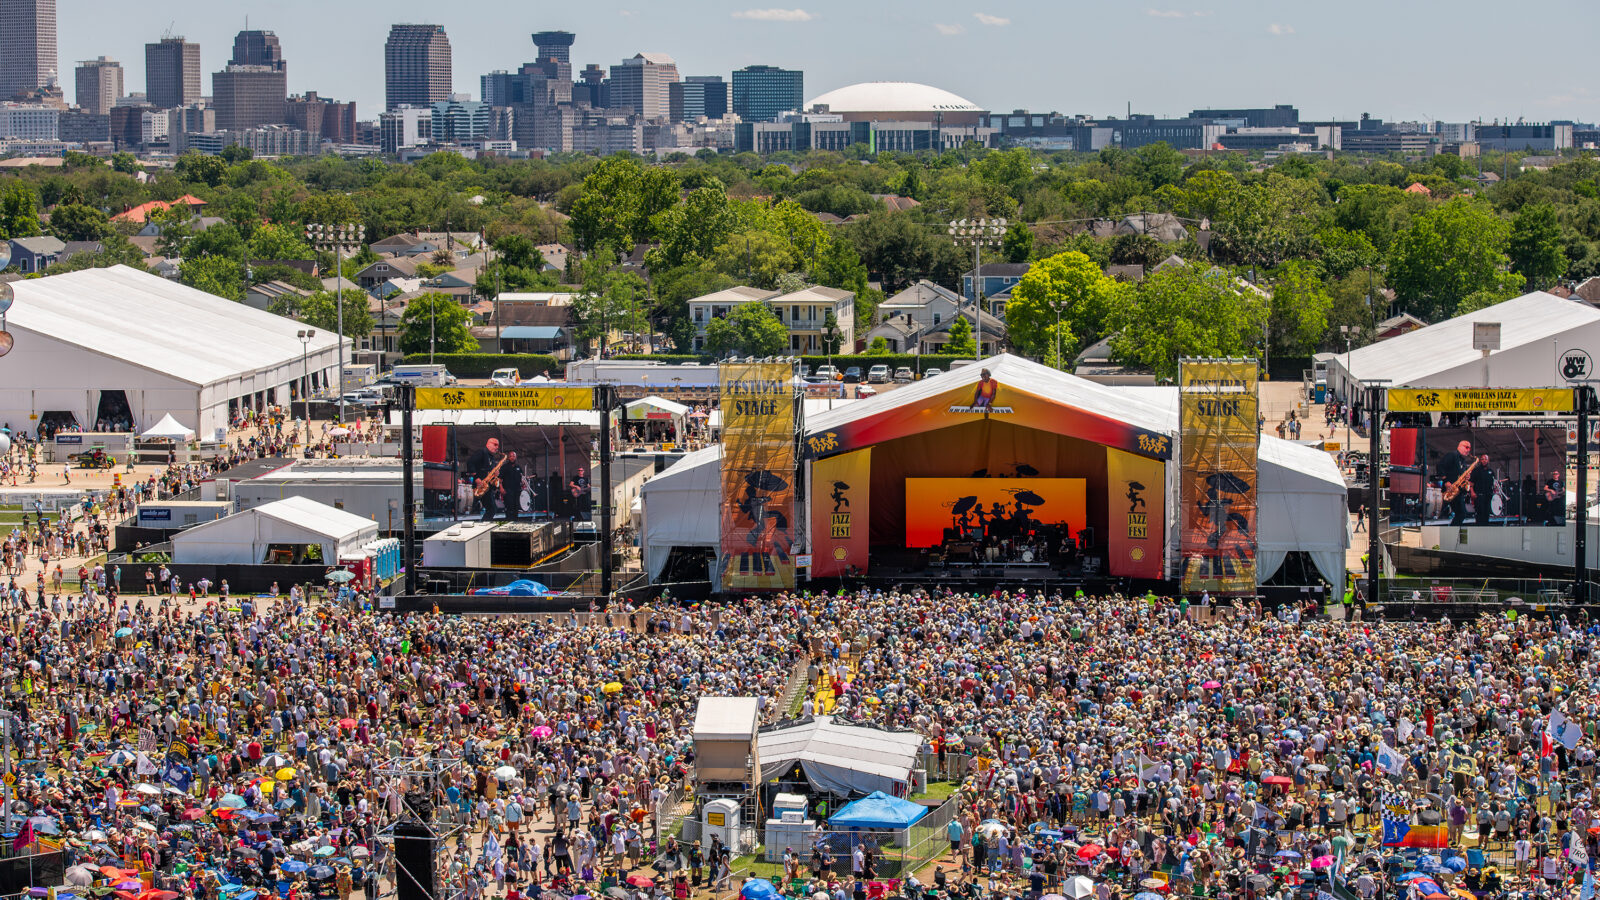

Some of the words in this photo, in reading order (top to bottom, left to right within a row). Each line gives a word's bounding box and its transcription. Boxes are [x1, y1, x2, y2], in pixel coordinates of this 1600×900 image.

[727, 379, 786, 395] FESTIVAL
[479, 390, 492, 398] NEW
[493, 390, 519, 398] ORLEANS
[520, 390, 533, 398] JAZZ
[1454, 391, 1468, 399] NEW
[1469, 391, 1496, 399] ORLEANS
[1497, 391, 1511, 399] JAZZ
[479, 399, 510, 407] HERITAGE
[511, 399, 539, 407] FESTIVAL
[736, 400, 777, 416] STAGE
[1197, 400, 1241, 416] STAGE
[1454, 401, 1487, 409] HERITAGE
[1488, 401, 1517, 409] FESTIVAL
[832, 513, 850, 525] JAZZ
[1128, 513, 1147, 525] JAZZ
[832, 526, 850, 537] FEST
[1128, 526, 1147, 537] FEST
